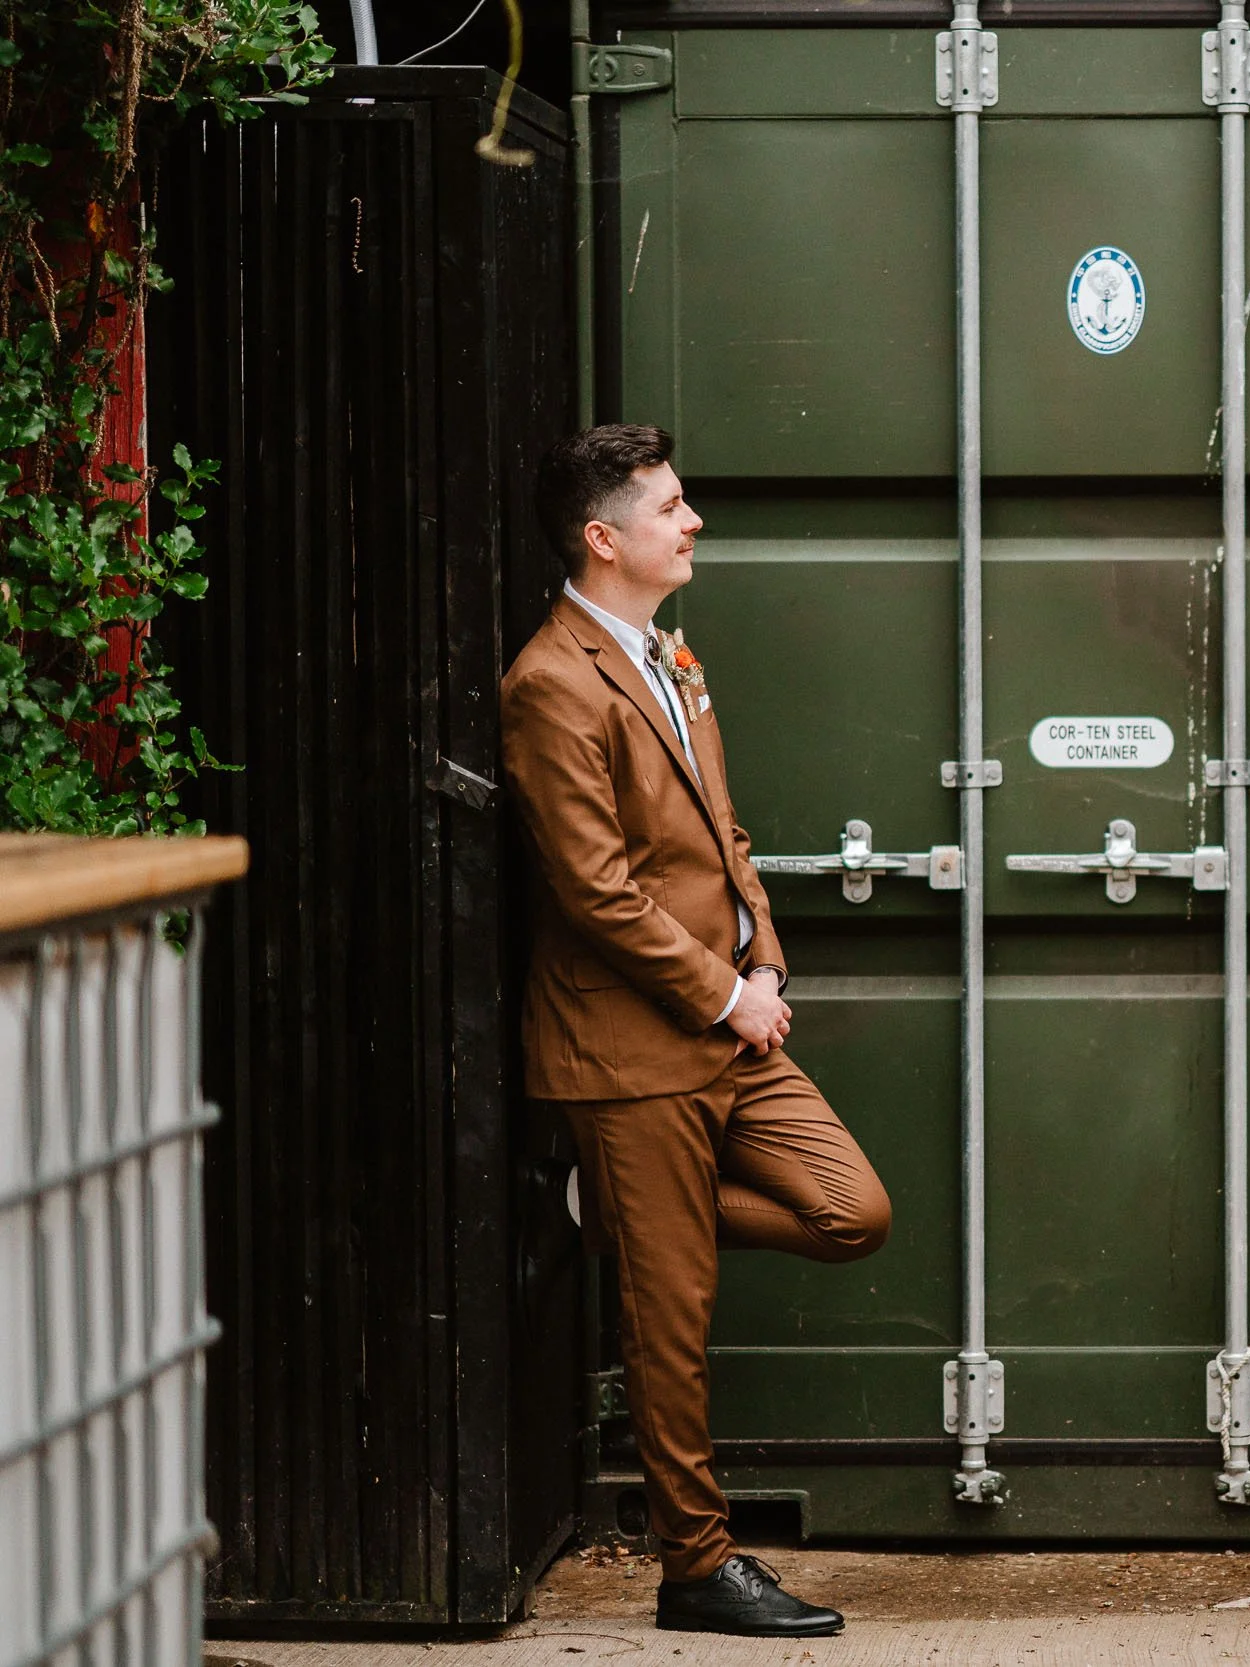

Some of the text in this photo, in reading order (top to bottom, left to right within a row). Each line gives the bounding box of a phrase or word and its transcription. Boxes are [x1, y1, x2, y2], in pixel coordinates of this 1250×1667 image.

[1050, 725, 1156, 740] COR-TEN STEEL
[1067, 745, 1138, 760] CONTAINER
